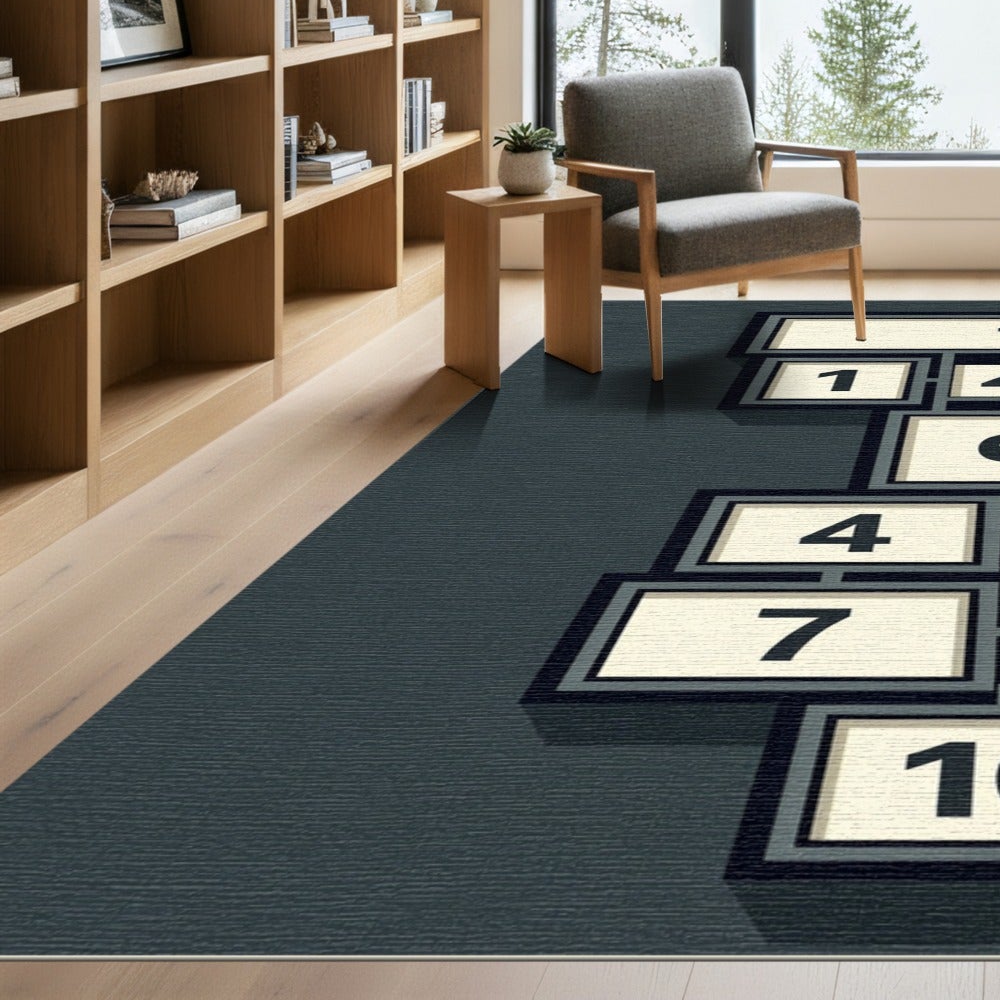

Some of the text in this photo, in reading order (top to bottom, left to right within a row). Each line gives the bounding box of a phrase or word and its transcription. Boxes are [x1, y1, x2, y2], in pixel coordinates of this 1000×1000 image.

[818, 370, 858, 392] 1
[799, 514, 892, 552] 4
[758, 609, 851, 661] 7
